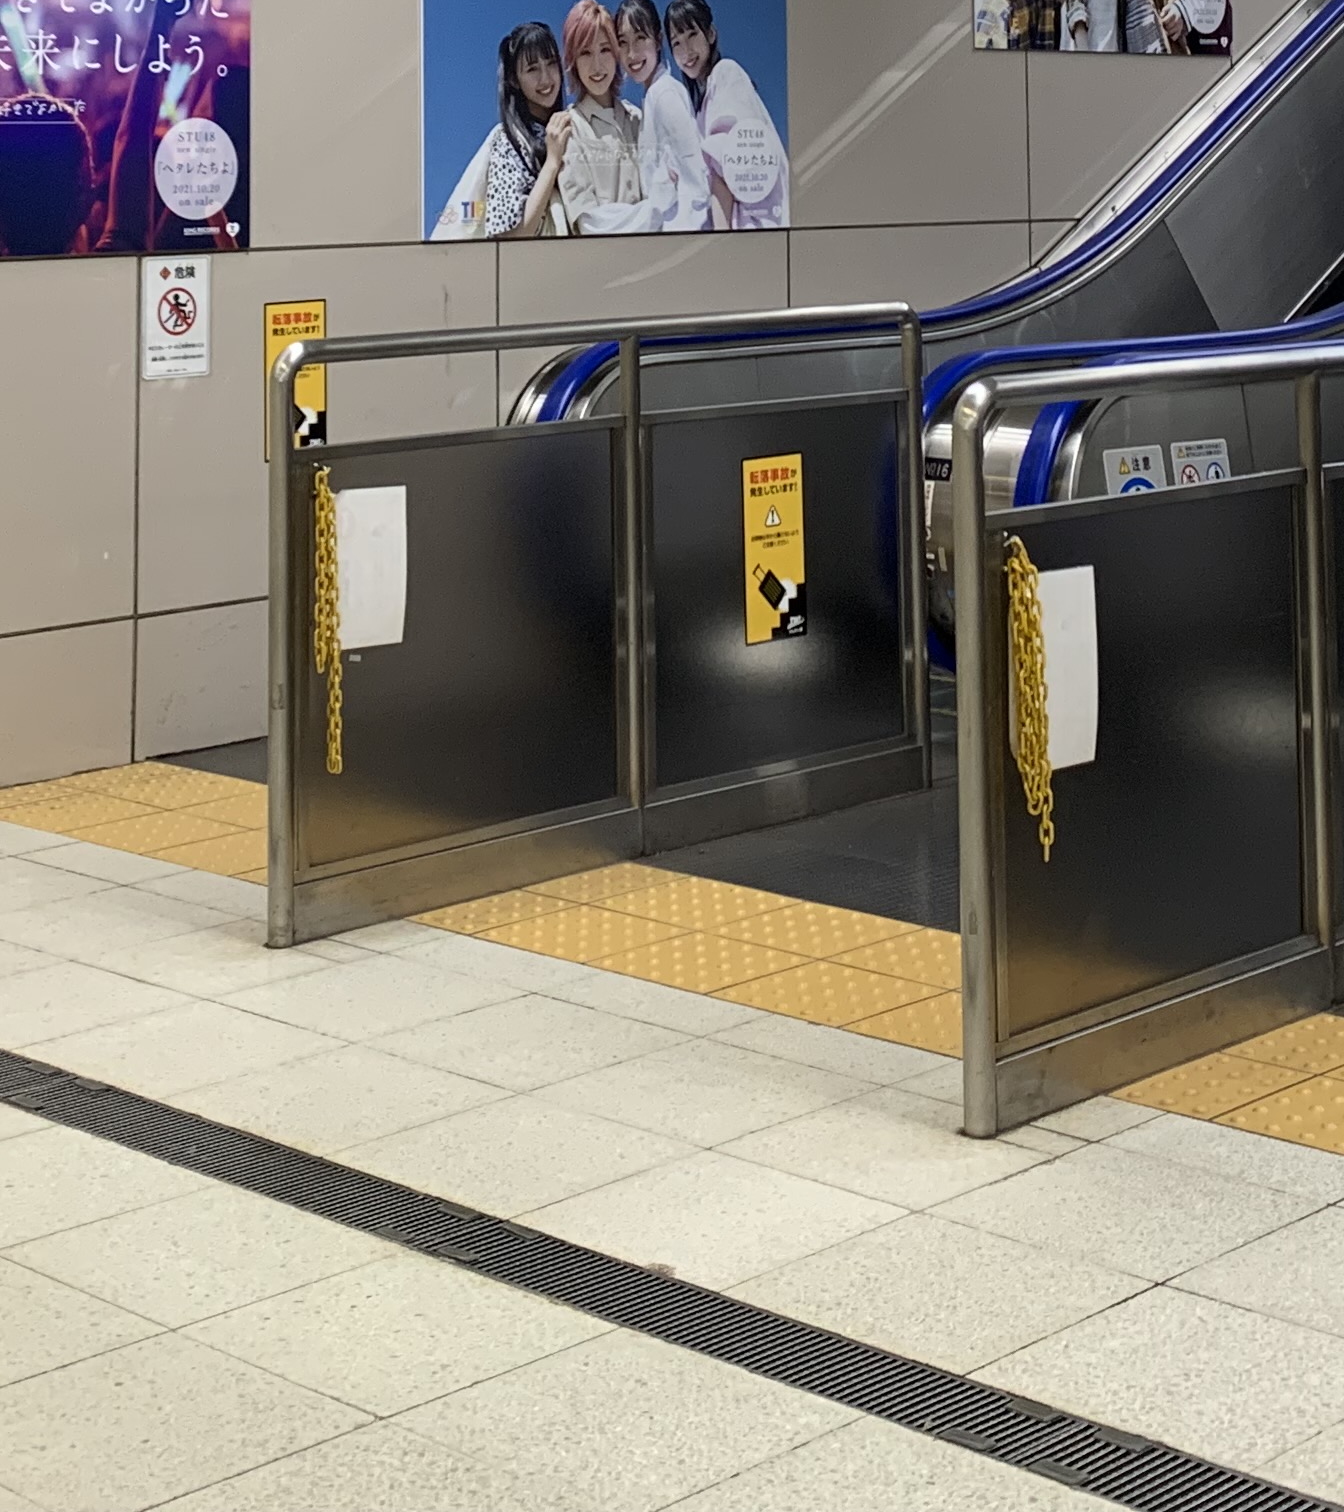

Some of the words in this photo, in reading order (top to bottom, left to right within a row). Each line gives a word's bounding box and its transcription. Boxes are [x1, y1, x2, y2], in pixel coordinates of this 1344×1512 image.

[178, 131, 216, 143] STU48
[175, 265, 196, 279] 危険
[272, 312, 320, 326] 転落事故が
[1132, 454, 1151, 471] 注意
[750, 467, 797, 484] 転落事故が
